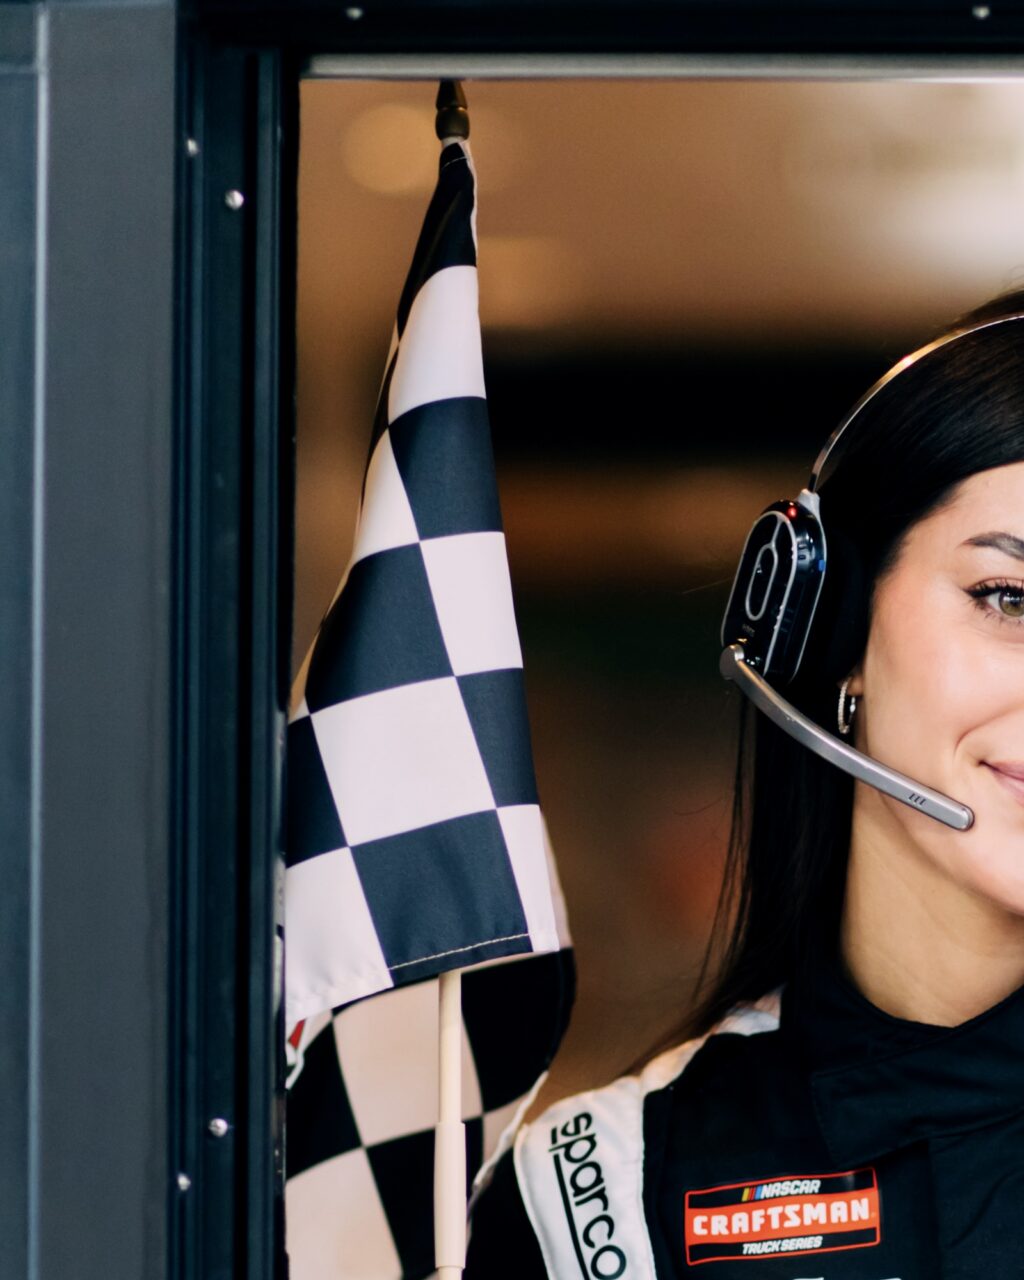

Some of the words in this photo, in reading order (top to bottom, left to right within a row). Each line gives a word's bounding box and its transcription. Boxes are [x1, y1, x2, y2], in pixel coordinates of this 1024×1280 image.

[760, 1179, 821, 1200] NASCAR
[693, 1198, 869, 1236] CRAFTSMAN
[742, 1240, 780, 1255] TRUCK
[780, 1235, 823, 1251] SERIES
